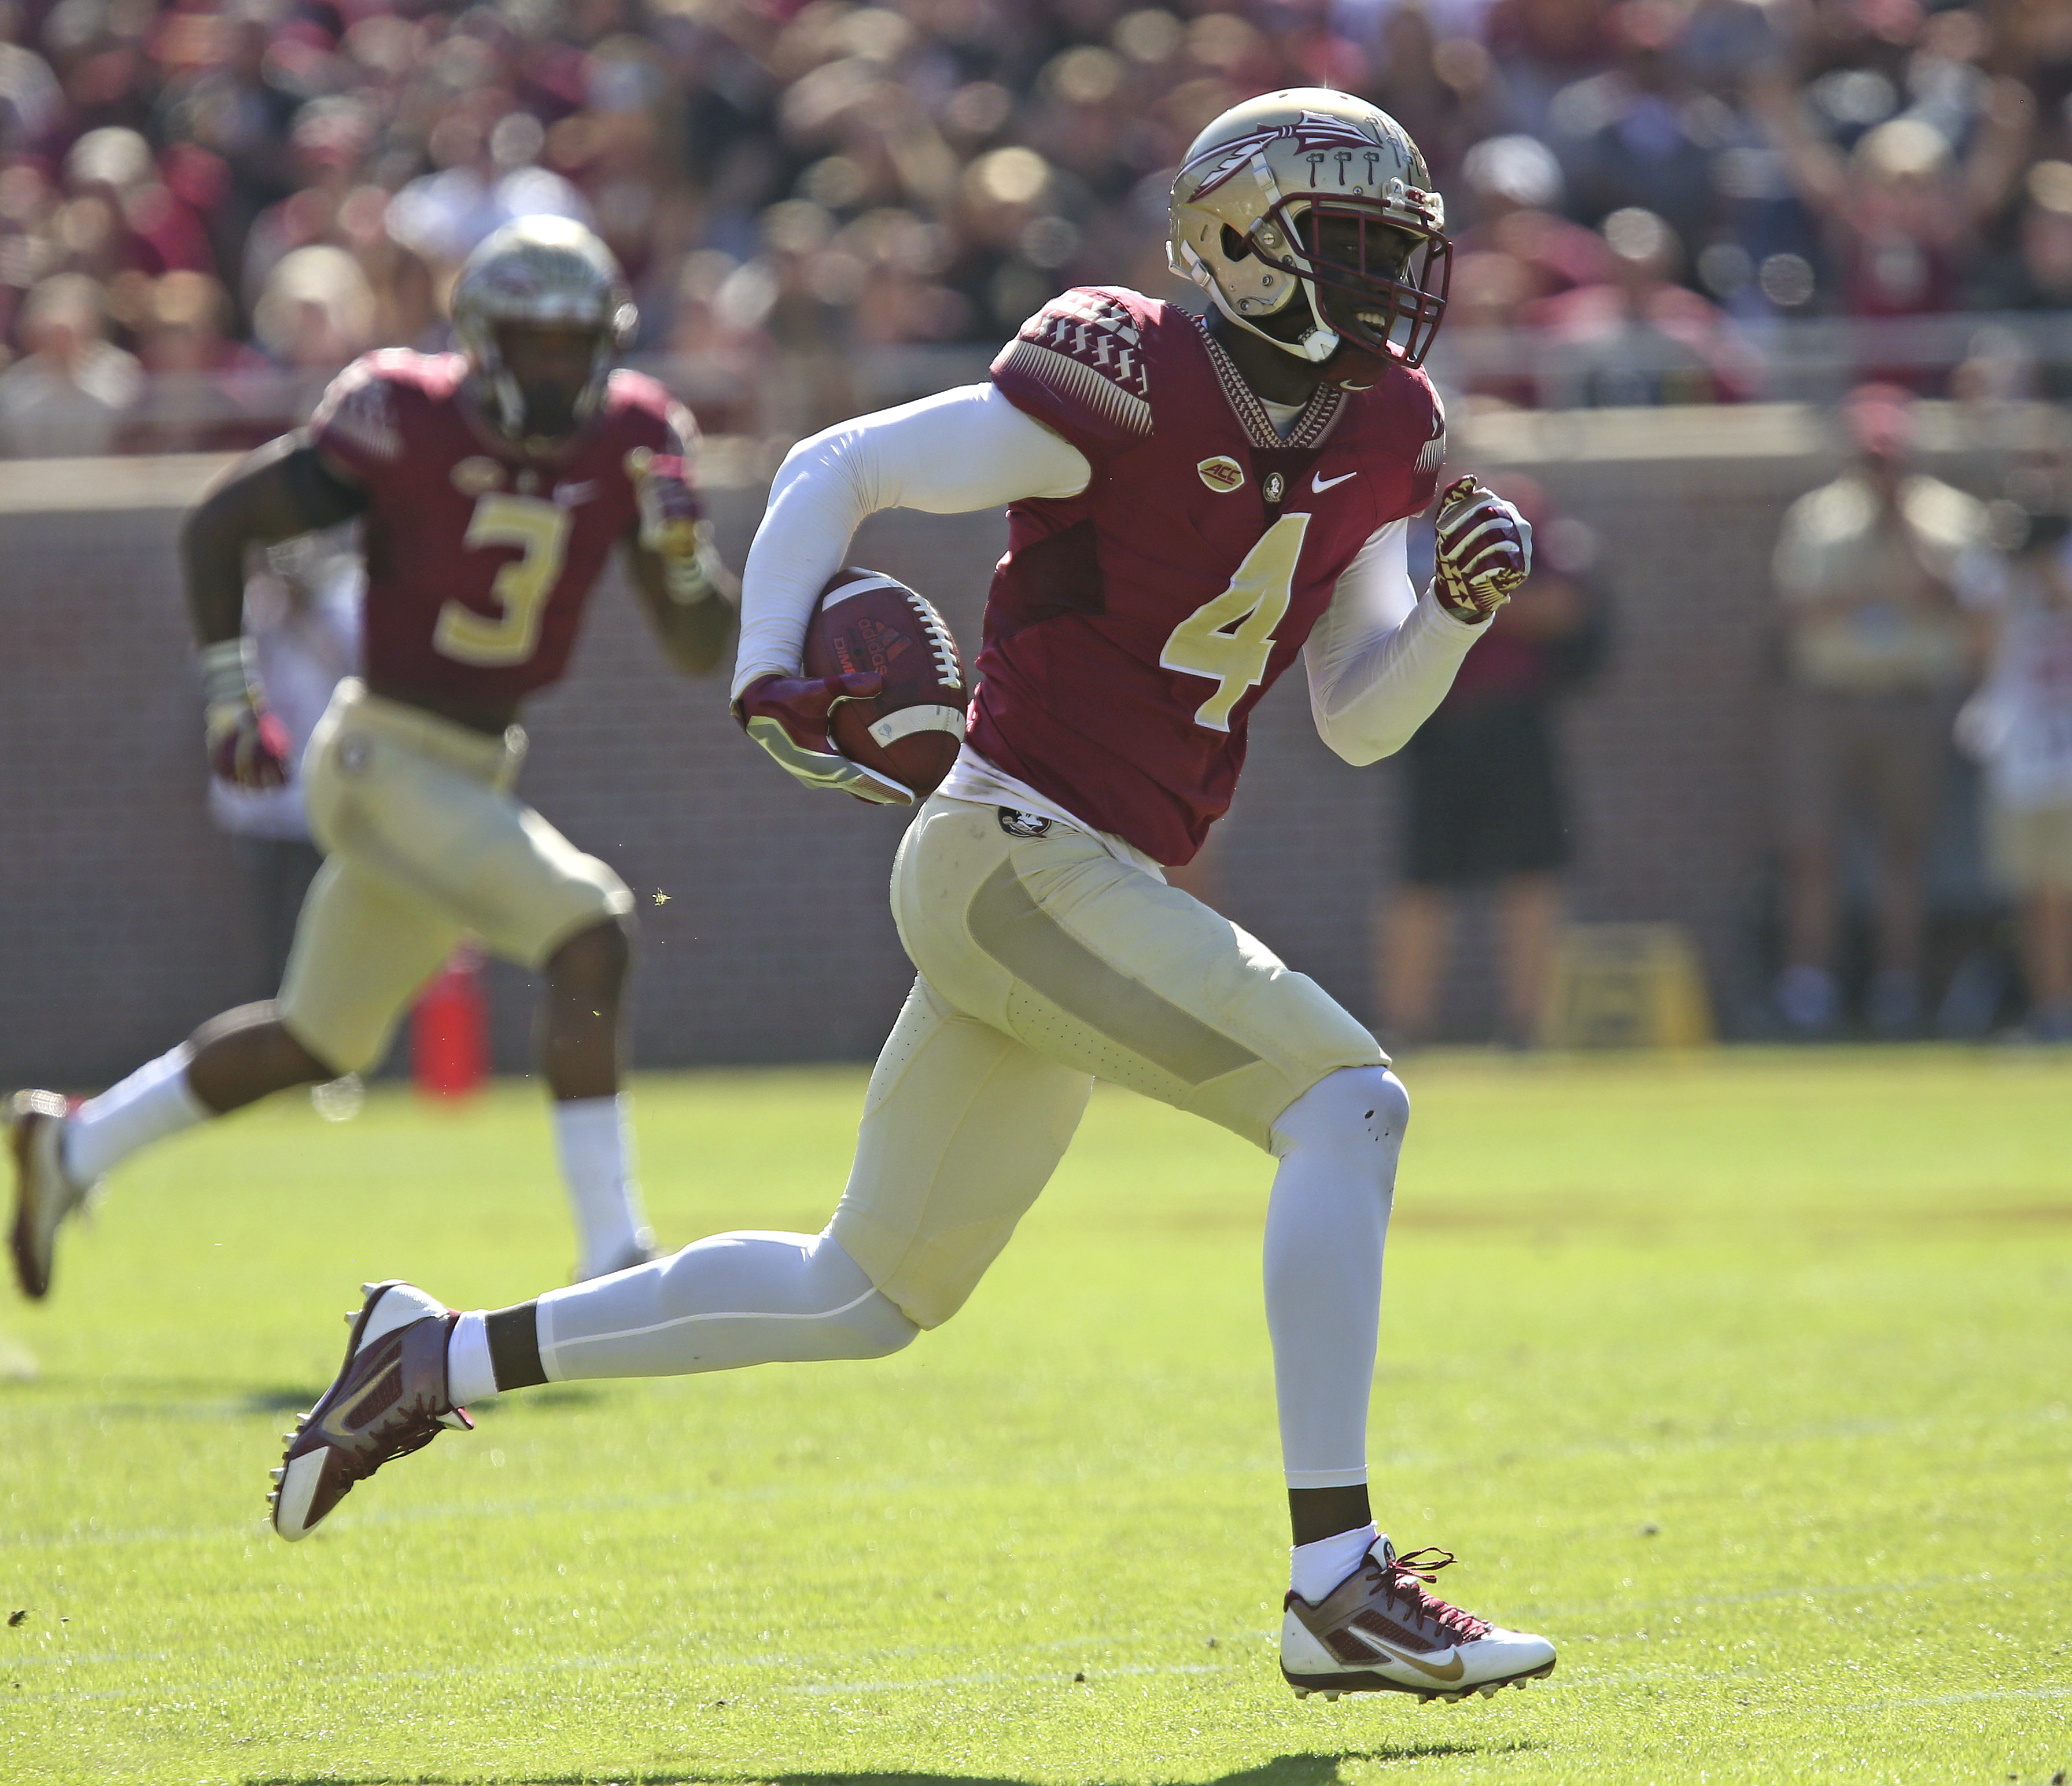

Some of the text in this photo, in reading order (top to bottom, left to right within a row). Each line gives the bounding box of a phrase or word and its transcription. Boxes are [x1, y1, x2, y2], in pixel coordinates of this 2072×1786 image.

[1204, 463, 1241, 483] ACC
[433, 491, 574, 667] 3
[1159, 512, 1312, 732] 4
[858, 618, 888, 676] adidas
